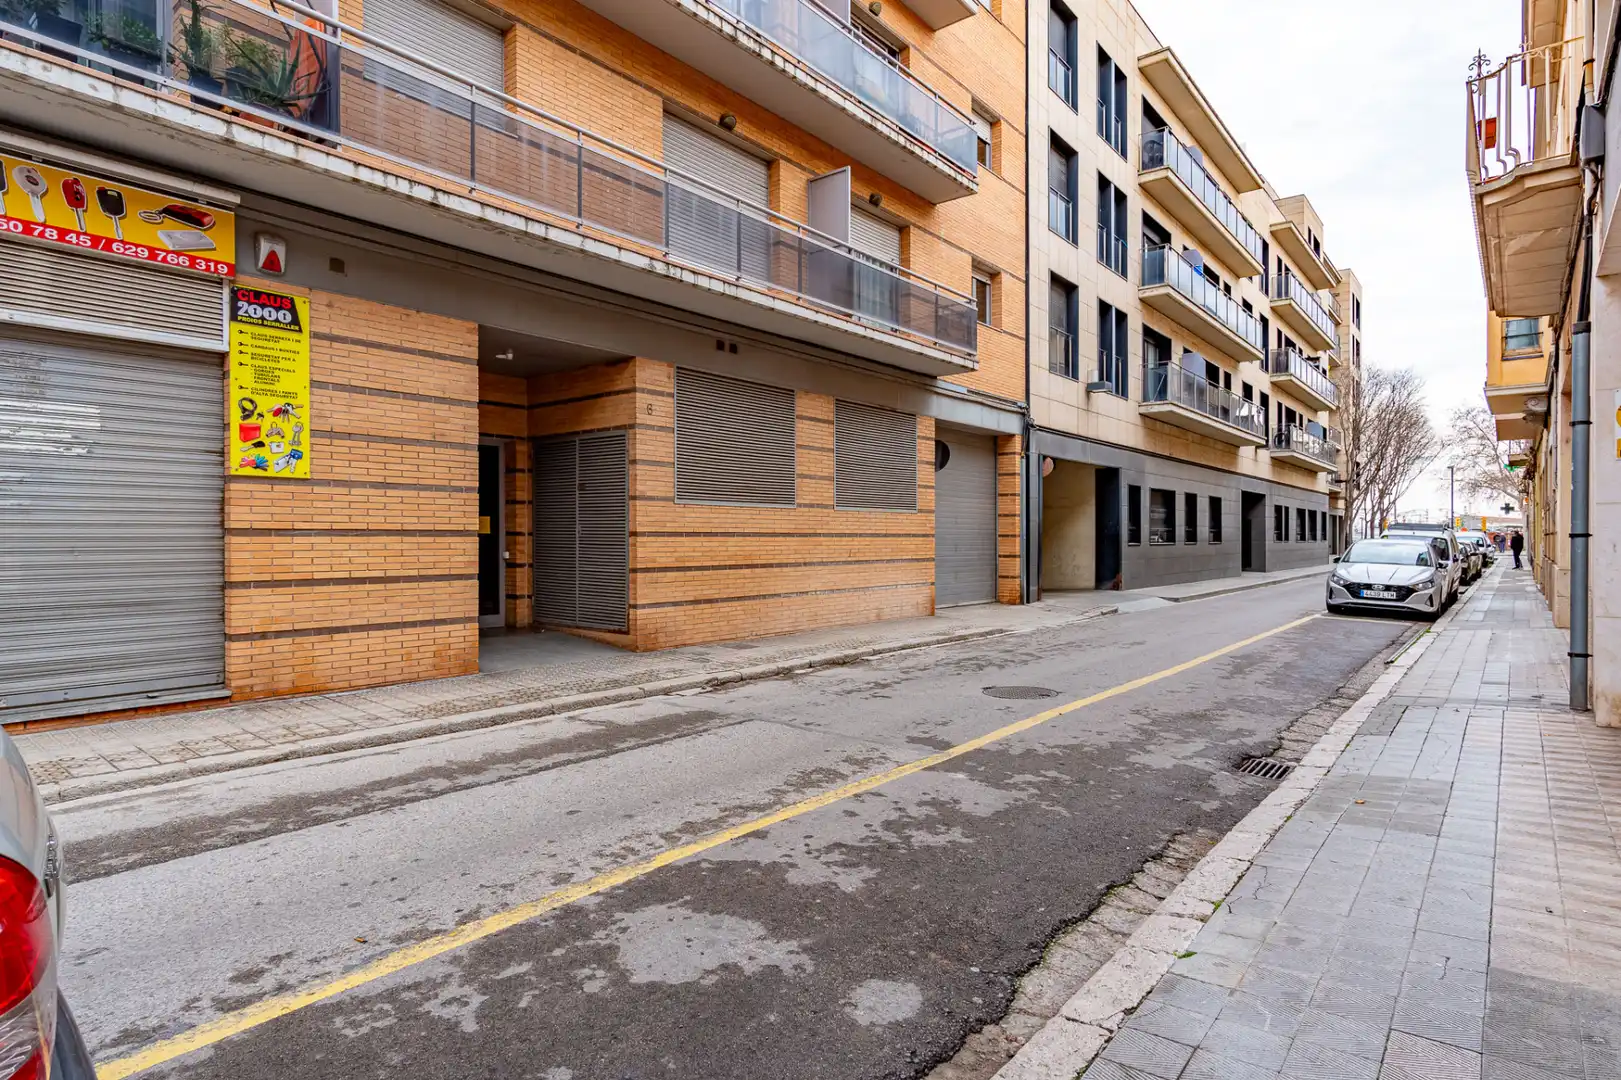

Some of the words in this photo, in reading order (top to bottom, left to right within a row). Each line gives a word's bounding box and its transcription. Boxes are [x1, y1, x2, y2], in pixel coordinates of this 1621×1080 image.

[30, 224, 58, 240] 78
[65, 233, 92, 247] 45
[98, 239, 106, 250] /
[111, 242, 149, 258] 629
[154, 250, 190, 266] 766
[195, 259, 228, 274] 319
[237, 289, 292, 309] CLAUS
[237, 301, 292, 323] 2000
[263, 320, 300, 330] SERRALLER
